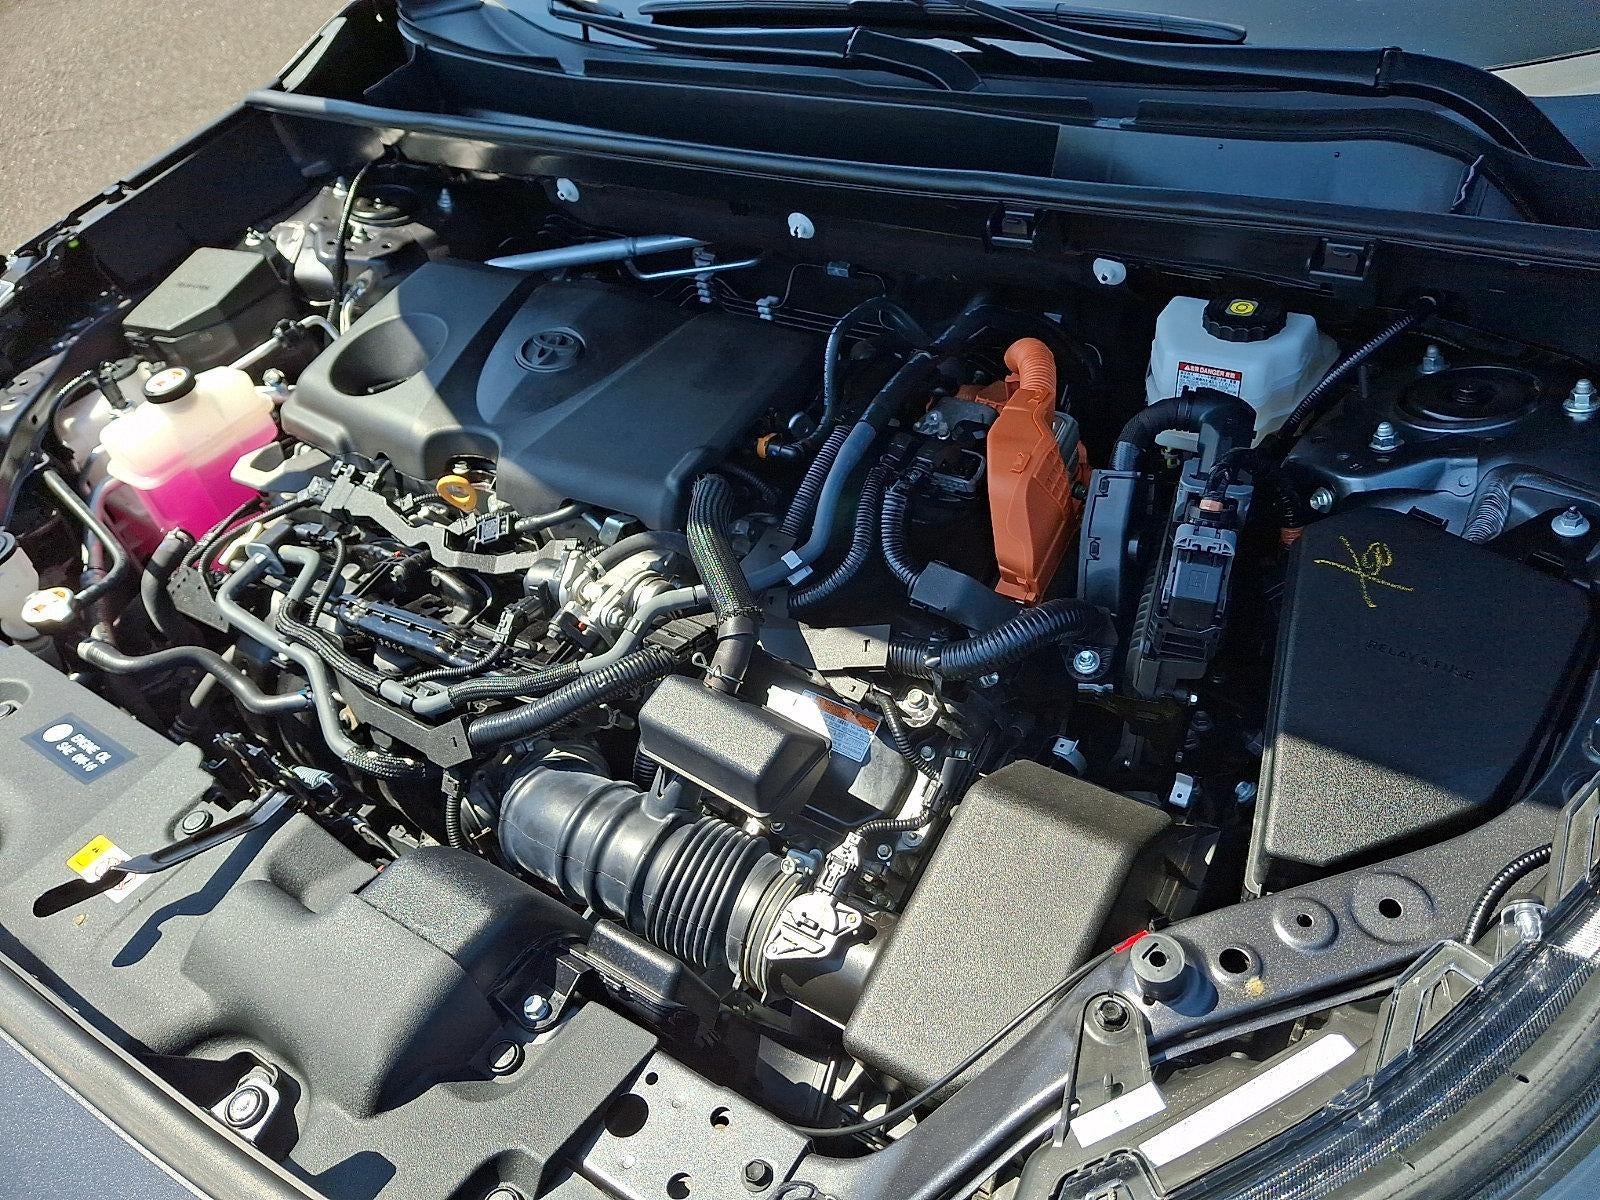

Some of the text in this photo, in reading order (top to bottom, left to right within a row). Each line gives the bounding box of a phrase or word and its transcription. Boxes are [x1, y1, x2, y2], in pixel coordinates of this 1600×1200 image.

[1199, 367, 1225, 376] DANGER
[56, 741, 77, 755] SAE
[70, 733, 100, 754] ENGINE
